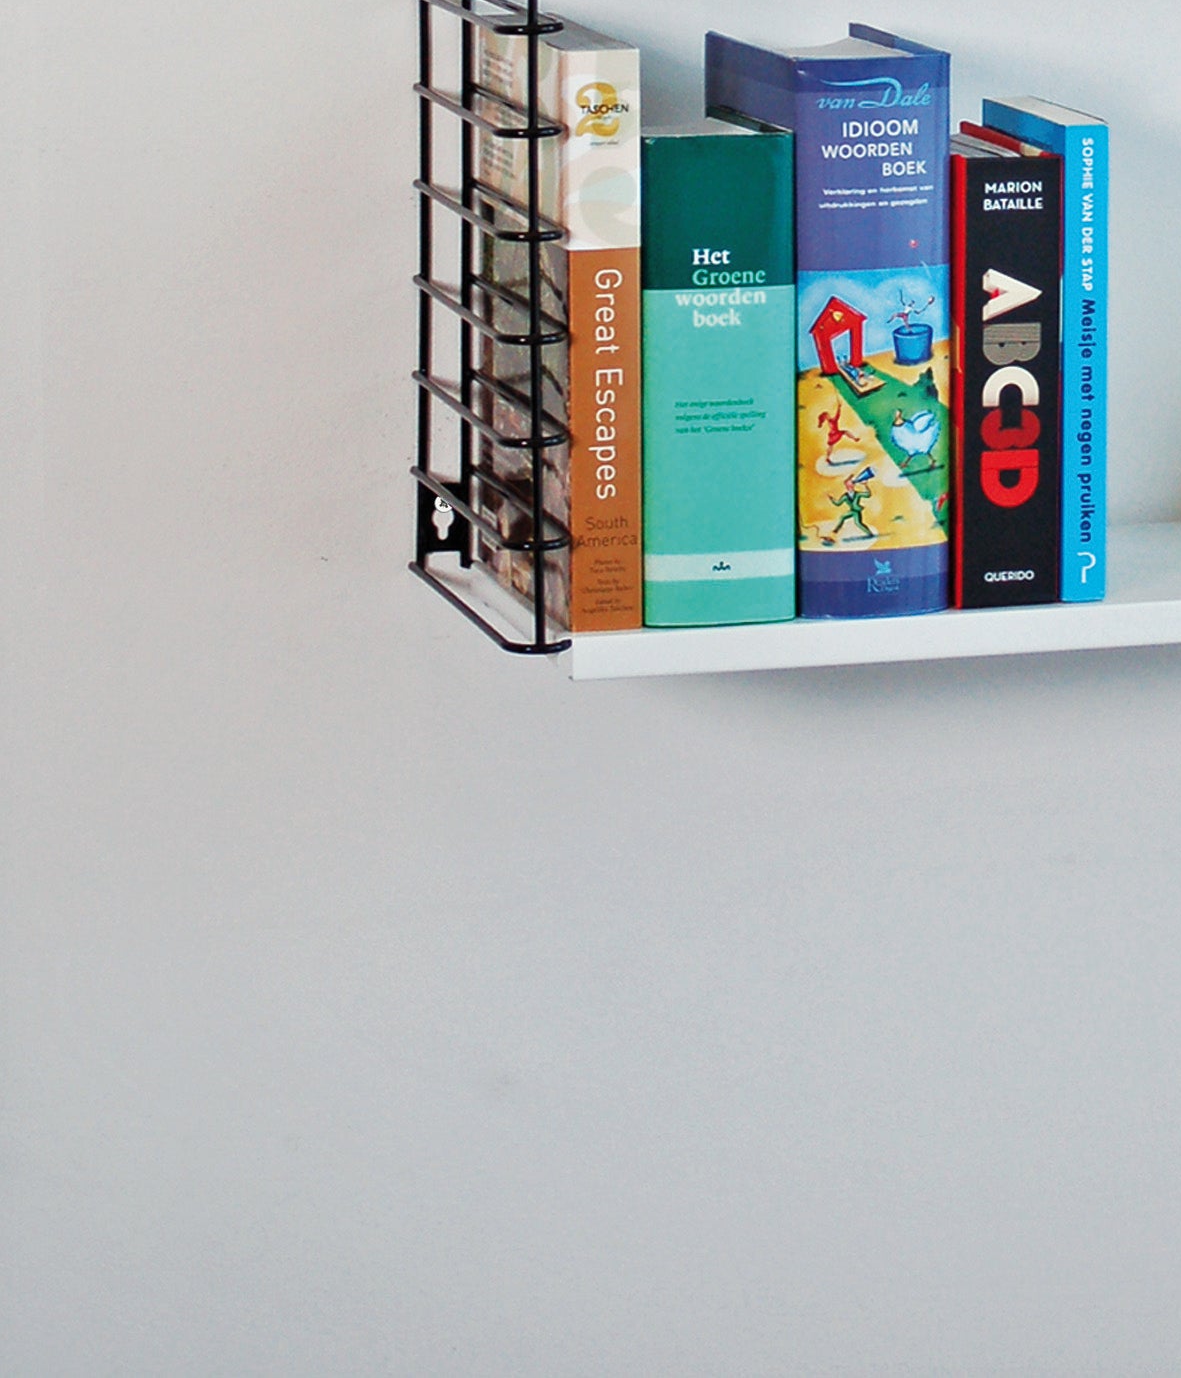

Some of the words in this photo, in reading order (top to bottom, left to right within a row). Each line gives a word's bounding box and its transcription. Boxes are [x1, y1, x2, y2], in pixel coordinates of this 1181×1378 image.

[820, 76, 932, 109] Dale
[816, 96, 856, 110] van
[842, 118, 919, 138] IDIOOM
[821, 141, 913, 159] WOORDEN
[882, 159, 927, 177] BOEK
[1081, 137, 1094, 190] SOPHIE
[984, 180, 1043, 195] MARION
[983, 196, 1045, 212] BATAILLE
[1081, 193, 1094, 223] VAN
[1081, 227, 1094, 254] DER
[692, 248, 731, 265] Het
[692, 268, 766, 286] Groene
[1081, 258, 1094, 292] STAP
[674, 287, 767, 307] woorden
[595, 268, 623, 355] Great
[692, 307, 741, 328] boek
[1079, 298, 1096, 359] Meisje
[1081, 365, 1095, 401] met
[587, 367, 623, 500] Escapes
[1077, 408, 1093, 466] negen
[1077, 472, 1096, 543] pruiken
[584, 515, 629, 531] South
[577, 534, 638, 547] America
[984, 569, 1035, 583] QUERIDO
